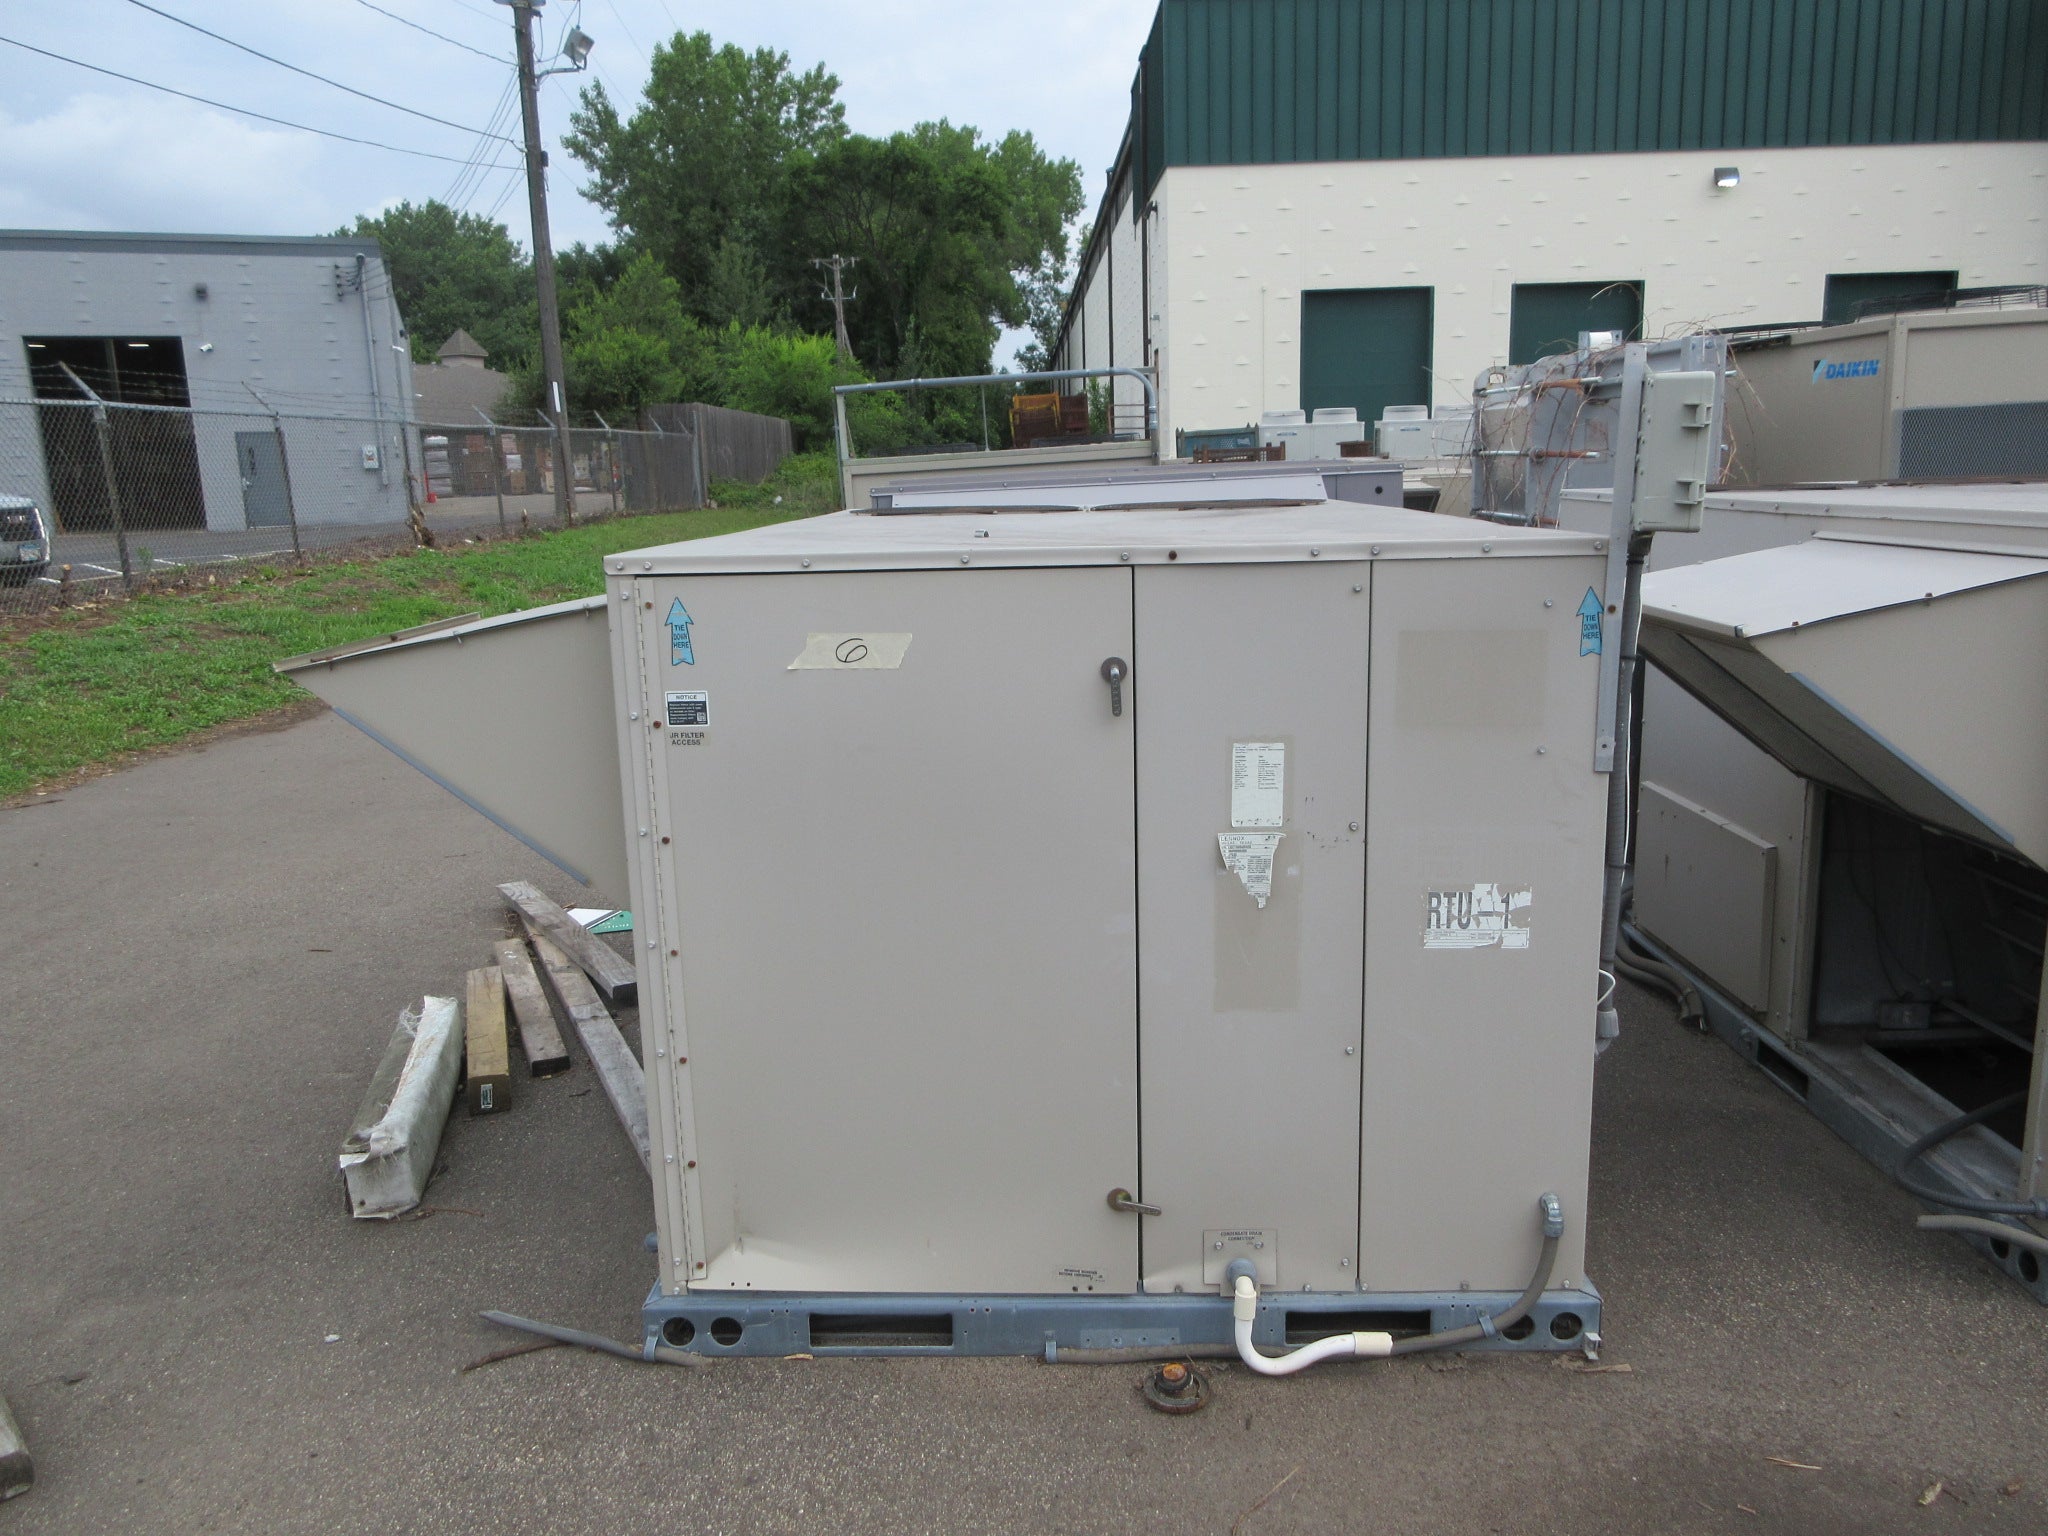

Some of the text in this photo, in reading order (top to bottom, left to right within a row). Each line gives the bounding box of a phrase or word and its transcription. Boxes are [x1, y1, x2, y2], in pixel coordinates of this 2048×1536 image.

[1825, 360, 1880, 379] DAIKIN
[1585, 614, 1597, 622] TIE
[1583, 623, 1598, 631] DOWN
[673, 633, 688, 641] DOWN
[1583, 632, 1600, 640] HERE
[673, 641, 689, 649] HERE
[835, 637, 868, 664] 6
